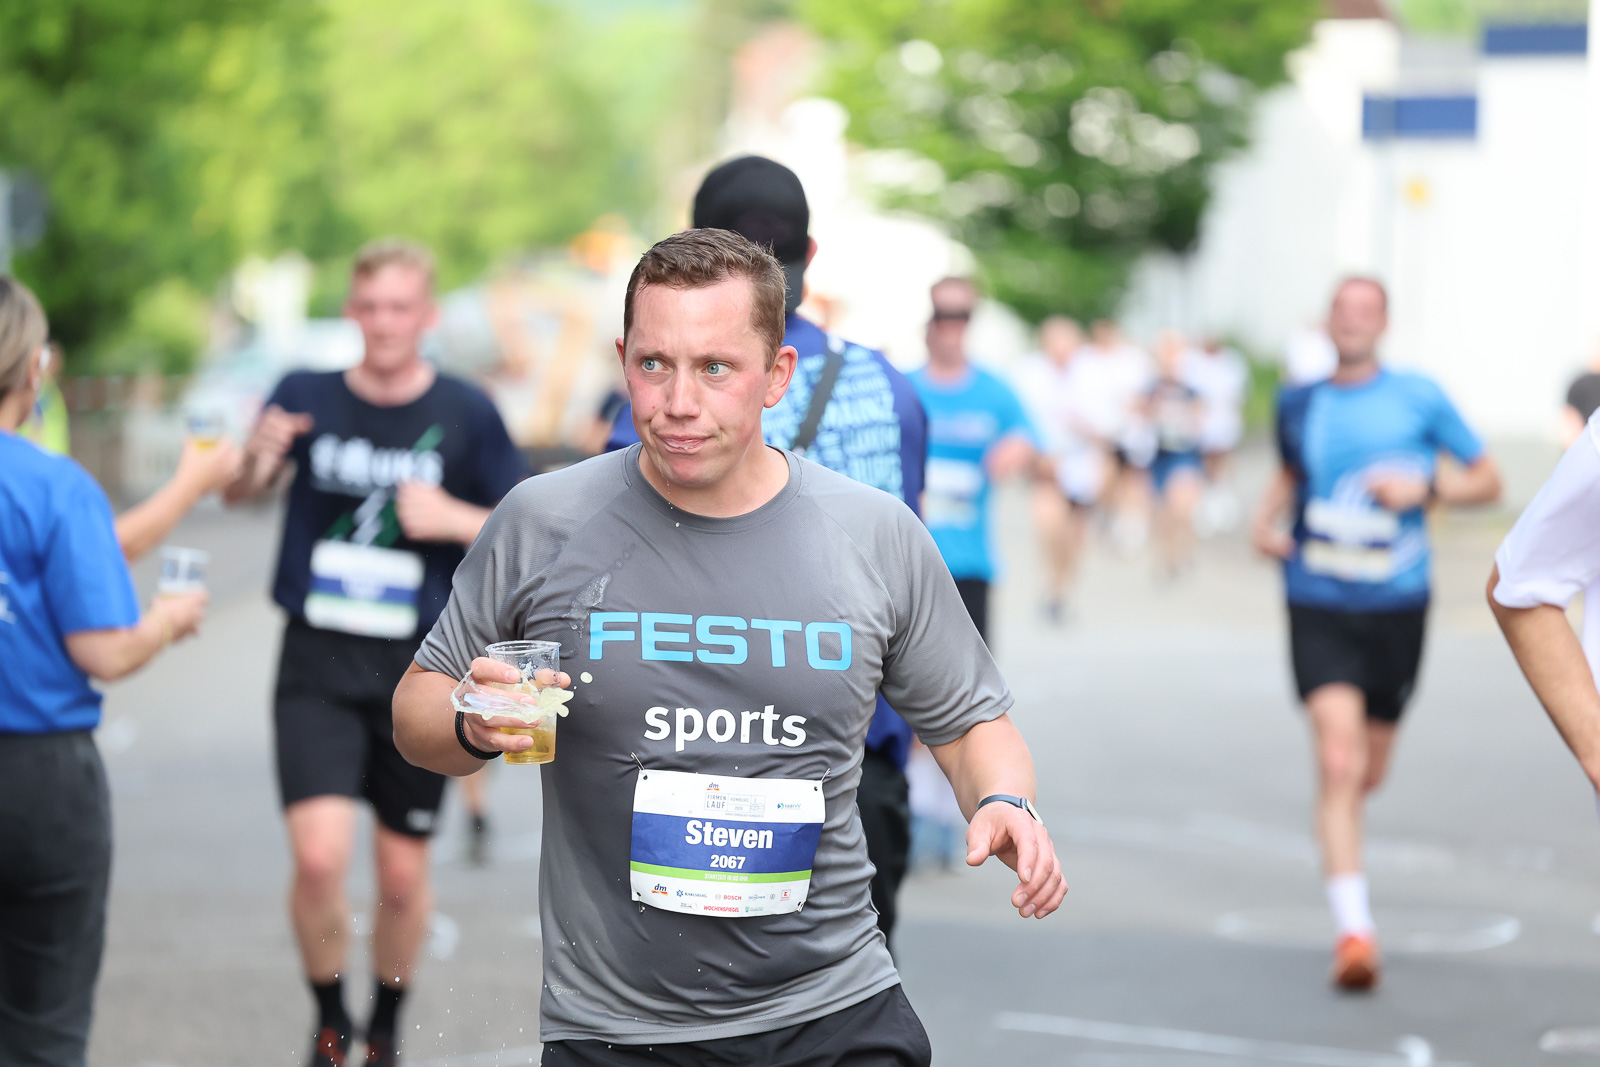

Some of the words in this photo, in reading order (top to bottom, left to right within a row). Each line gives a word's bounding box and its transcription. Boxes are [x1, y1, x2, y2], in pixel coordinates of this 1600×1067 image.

[589, 611, 852, 671] FESTO
[643, 704, 807, 752] sports
[706, 800, 726, 809] LAUF
[685, 819, 774, 849] Steven
[709, 854, 746, 870] 2067
[654, 883, 667, 892] dm
[703, 905, 740, 913] WOCHENSPIEGEL
